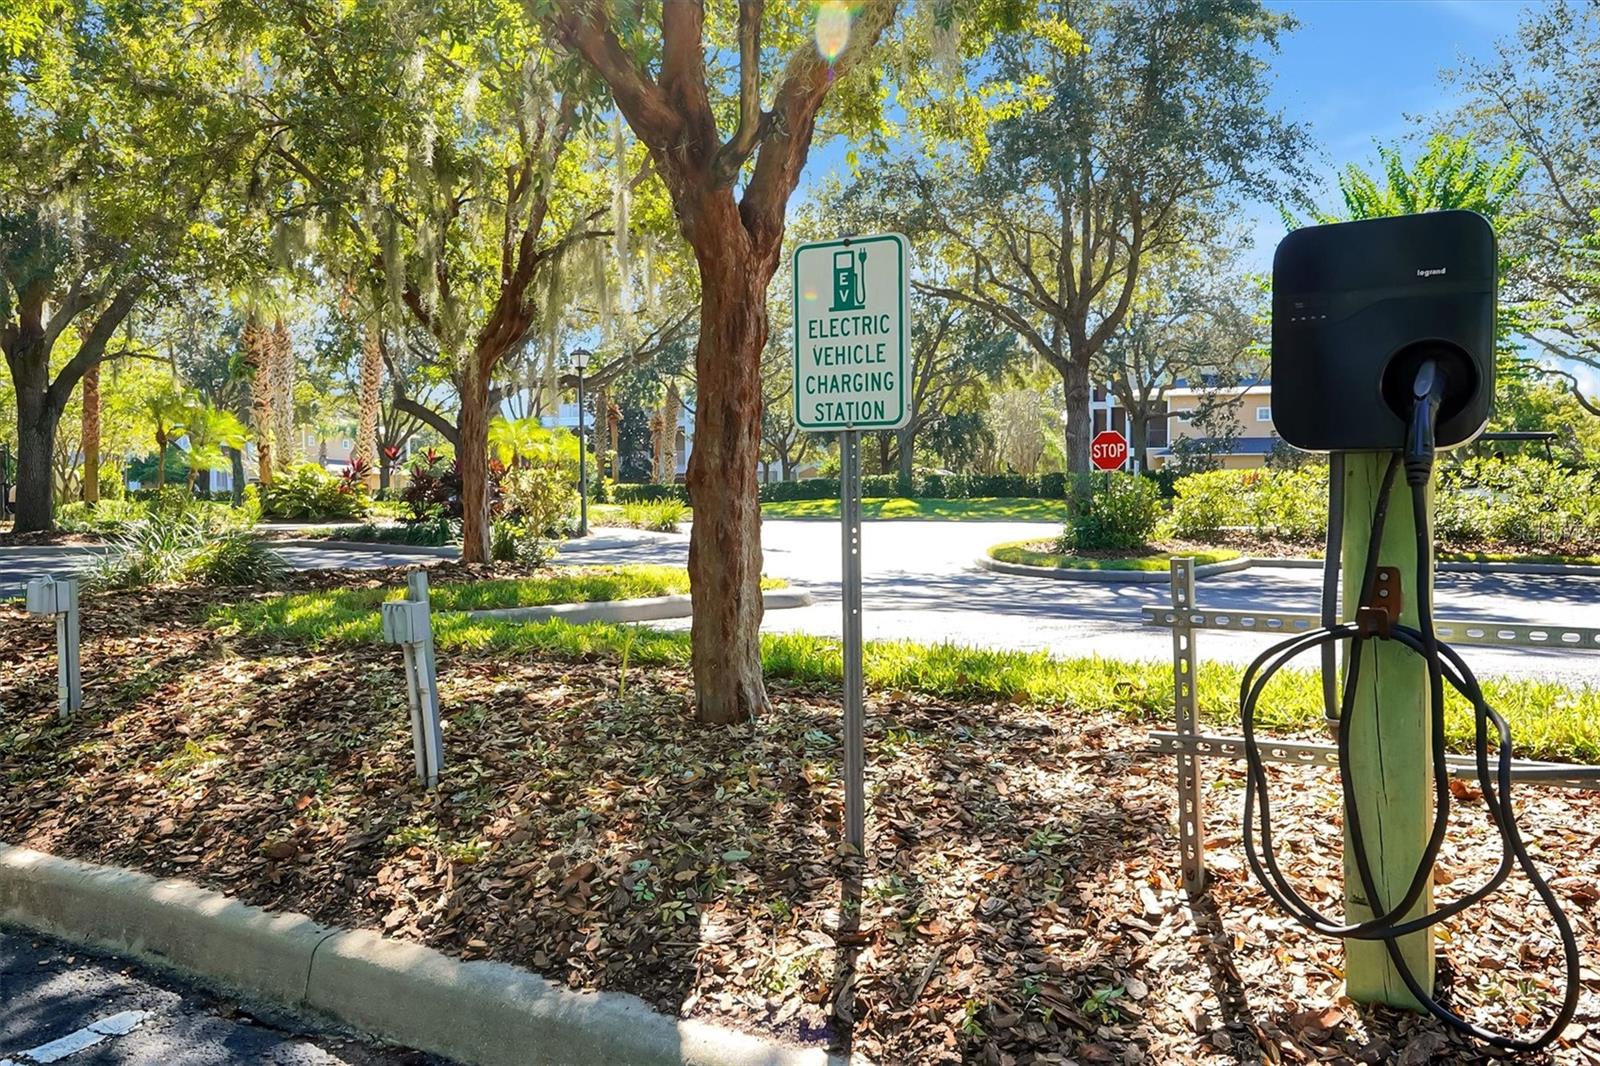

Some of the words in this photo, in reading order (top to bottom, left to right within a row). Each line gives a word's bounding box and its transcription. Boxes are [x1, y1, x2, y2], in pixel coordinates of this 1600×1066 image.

[1416, 267, 1446, 277] legrand
[809, 314, 890, 339] ELECTRIC
[813, 343, 886, 366] VEHICLE
[806, 371, 894, 394] CHARGING
[814, 401, 885, 422] STATION
[1093, 443, 1126, 459] STOP
